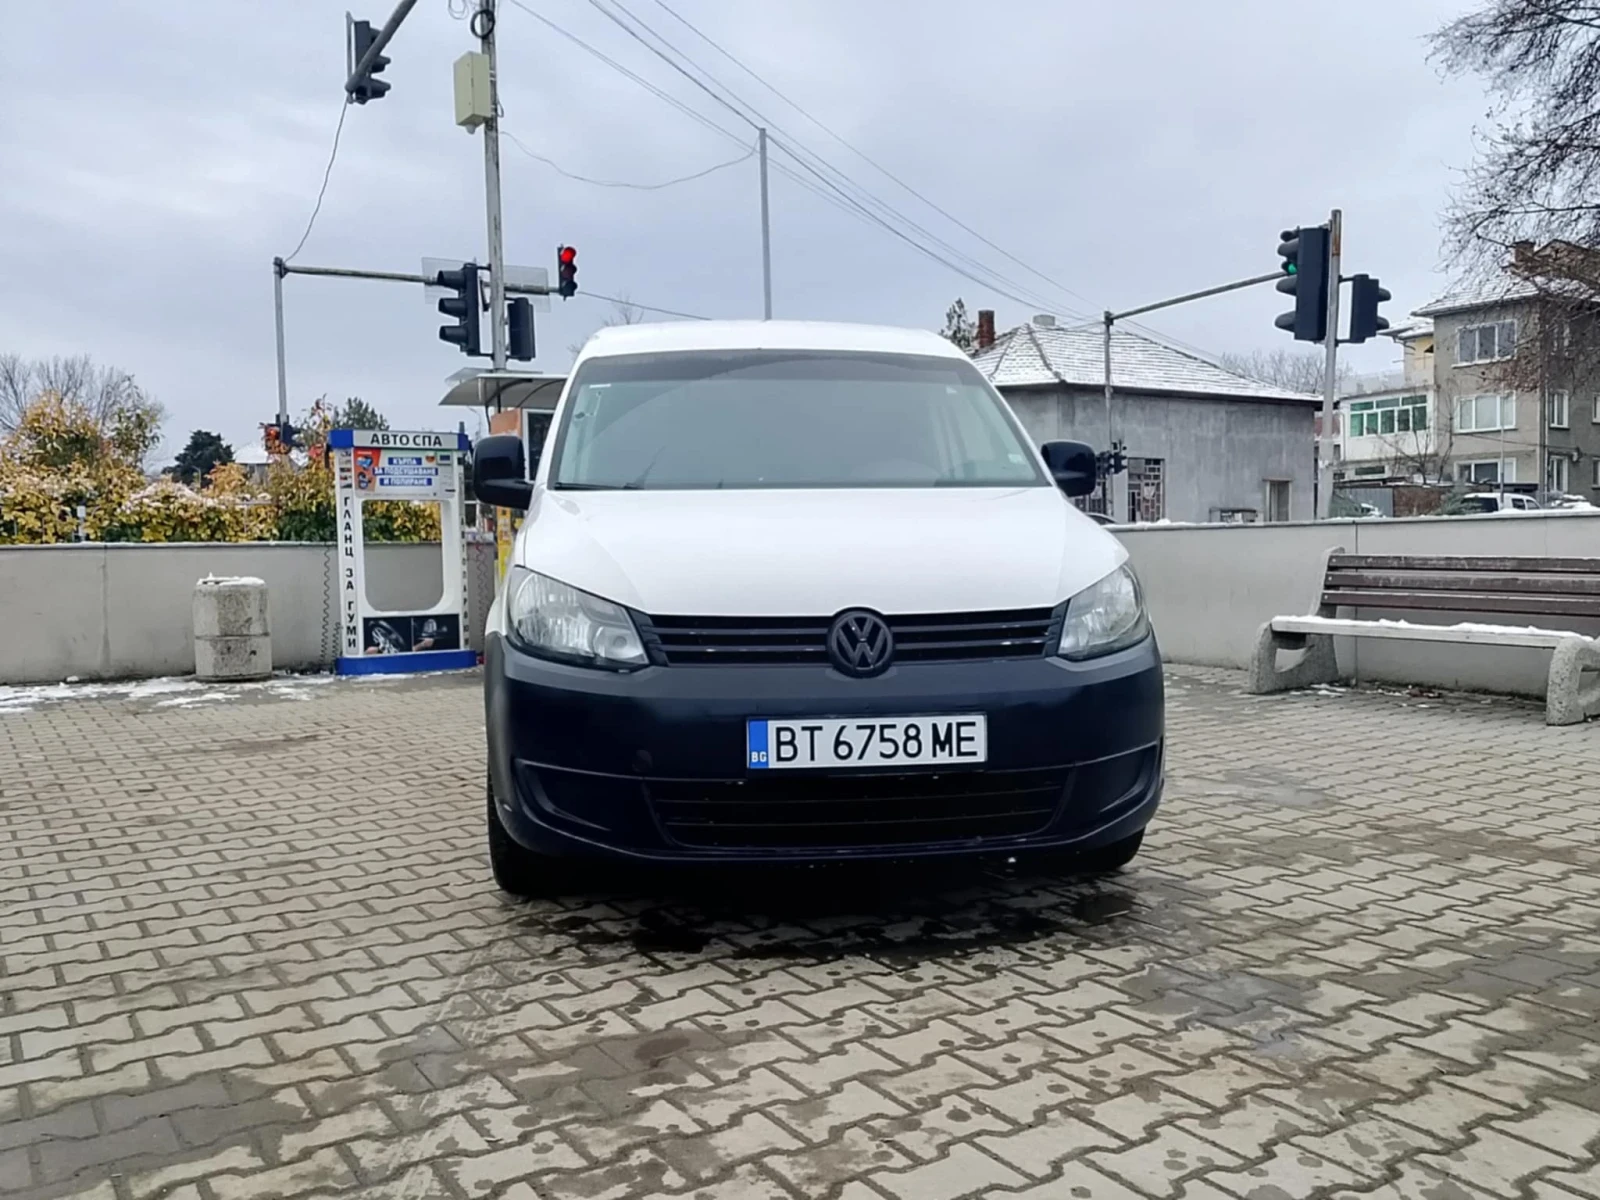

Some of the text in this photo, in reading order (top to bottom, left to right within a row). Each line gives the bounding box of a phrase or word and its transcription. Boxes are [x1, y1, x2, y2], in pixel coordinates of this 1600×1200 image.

[370, 433, 443, 447] АВТО СПА
[374, 467, 383, 475] ЗА
[343, 496, 357, 648] ГЛАНЦ ЗА ГУМИ
[775, 721, 978, 762] BT 6758 ME
[751, 751, 767, 762] BG
